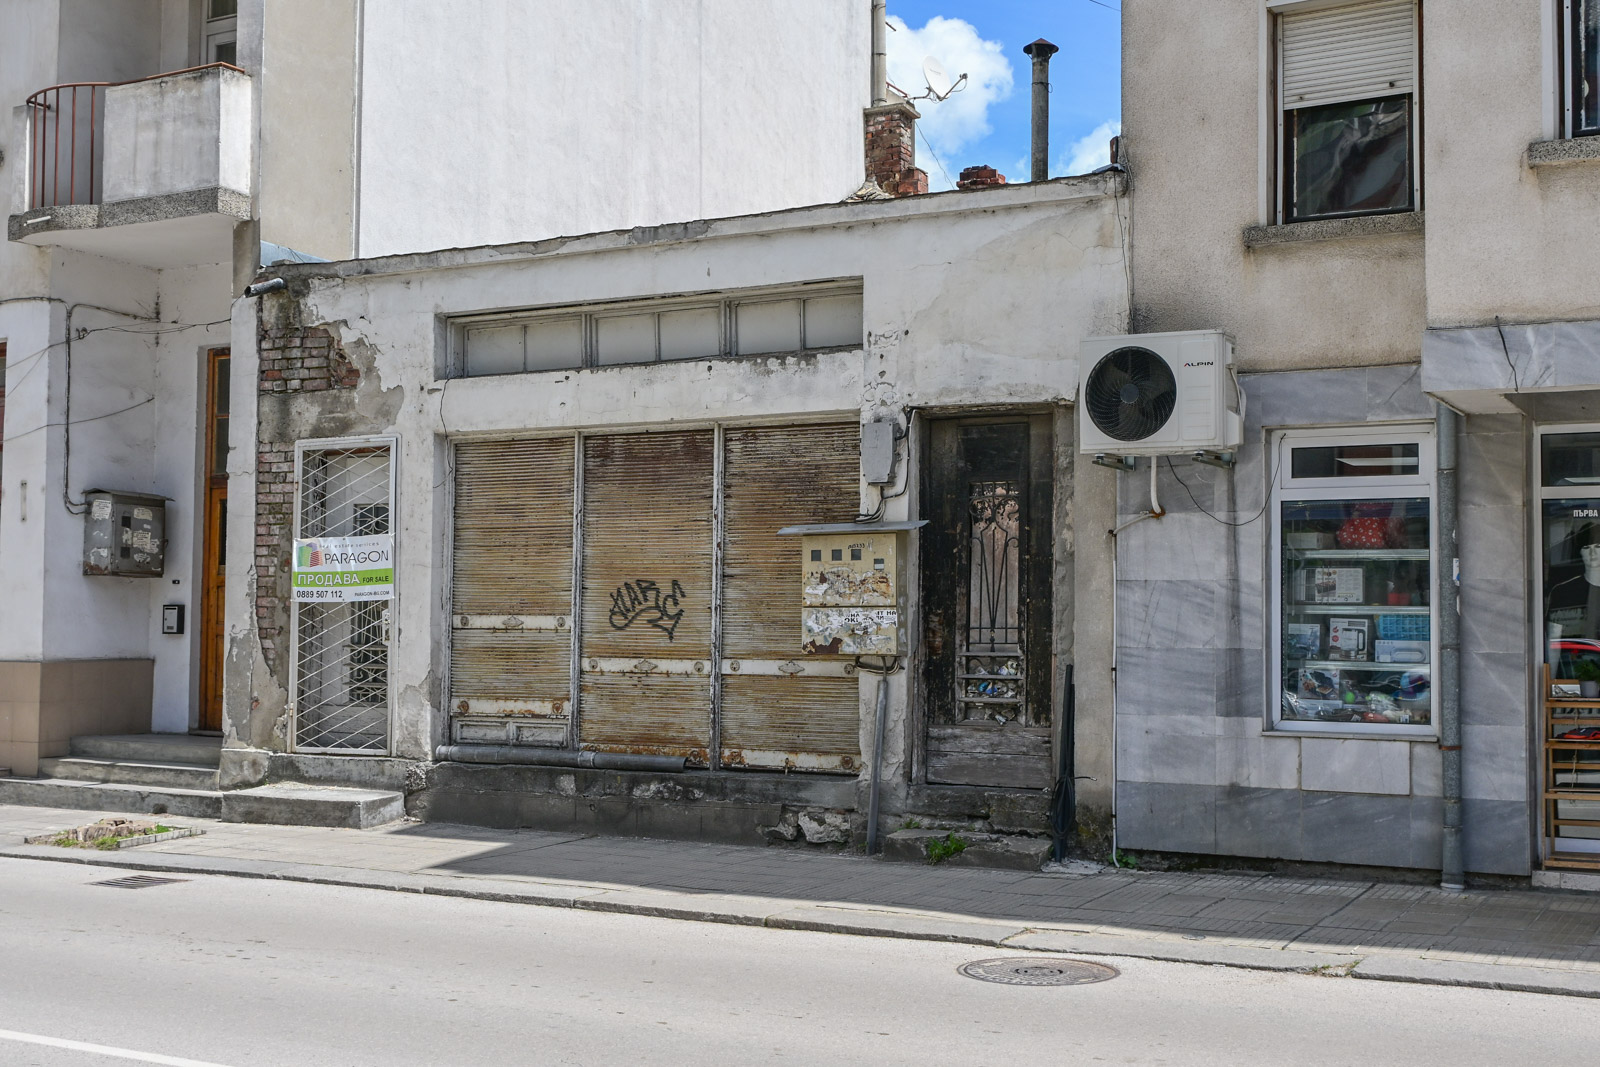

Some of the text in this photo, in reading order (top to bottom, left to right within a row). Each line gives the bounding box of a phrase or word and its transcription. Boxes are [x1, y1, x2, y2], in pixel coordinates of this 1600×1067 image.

[1573, 509, 1598, 517] ПЪРВА
[325, 550, 388, 564] PARAGON
[298, 574, 360, 586] ПРОДАВА
[331, 590, 343, 598] 112
